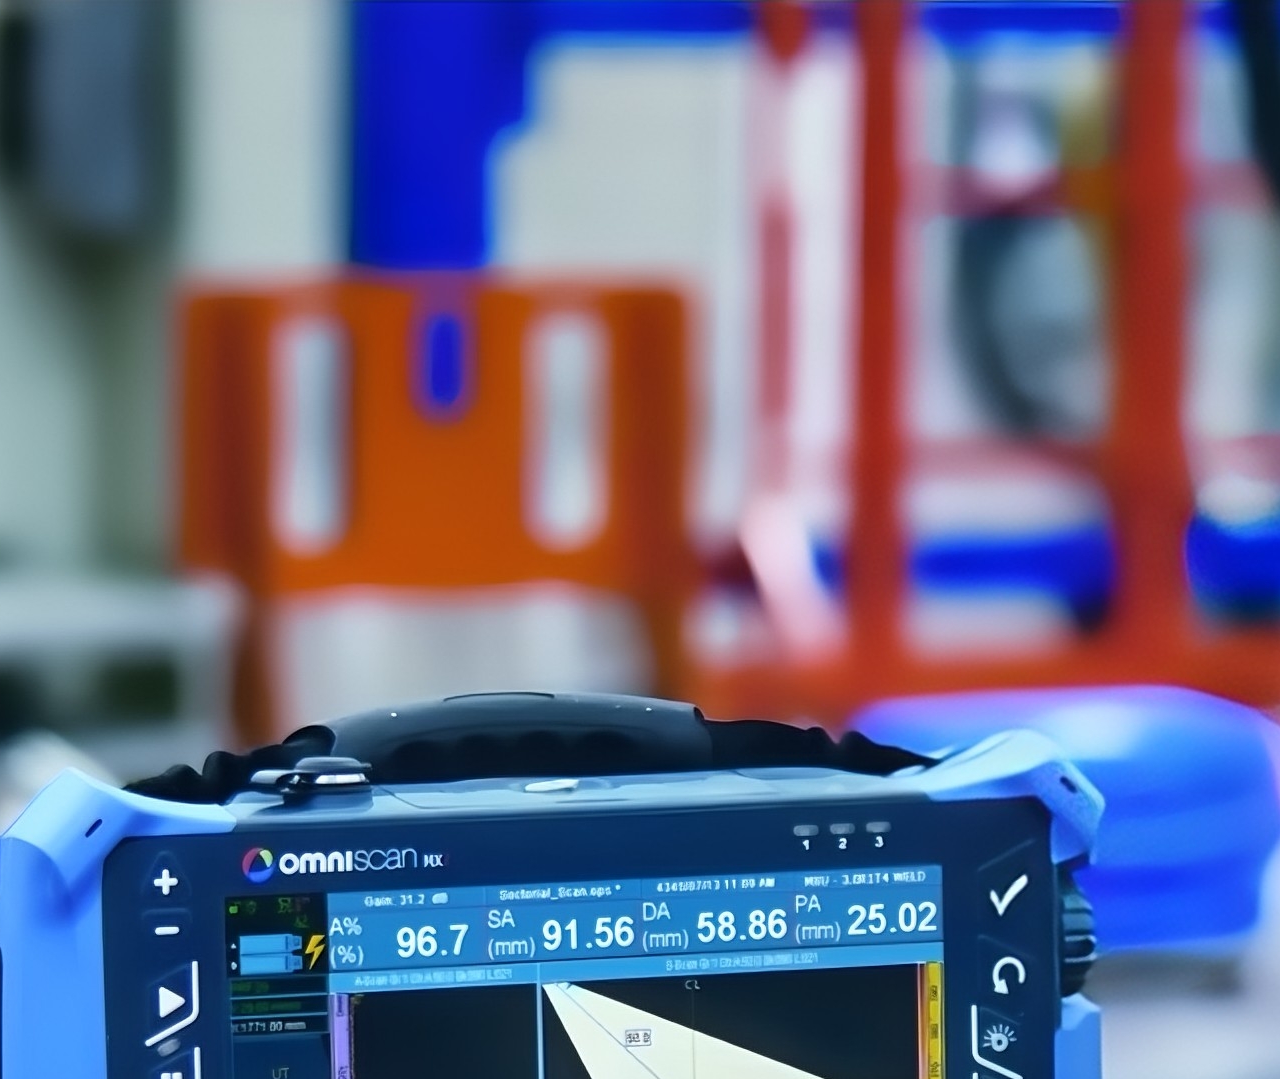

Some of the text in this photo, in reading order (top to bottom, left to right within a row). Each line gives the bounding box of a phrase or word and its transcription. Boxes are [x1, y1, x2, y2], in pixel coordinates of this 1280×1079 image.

[802, 836, 884, 850] 1 2 3
[642, 902, 671, 922] DA
[795, 894, 821, 914] PA
[329, 916, 362, 937] A%
[487, 909, 515, 929] SA
[696, 908, 788, 943] 58.86
[847, 901, 938, 936] 25.02
[396, 923, 469, 958] 96.7
[542, 915, 635, 951] 91.56
[642, 929, 689, 953] (mm)
[795, 921, 841, 944] (mm)
[329, 945, 364, 969] (%)
[487, 936, 536, 960] (mm)
[272, 1067, 290, 1079] UT
